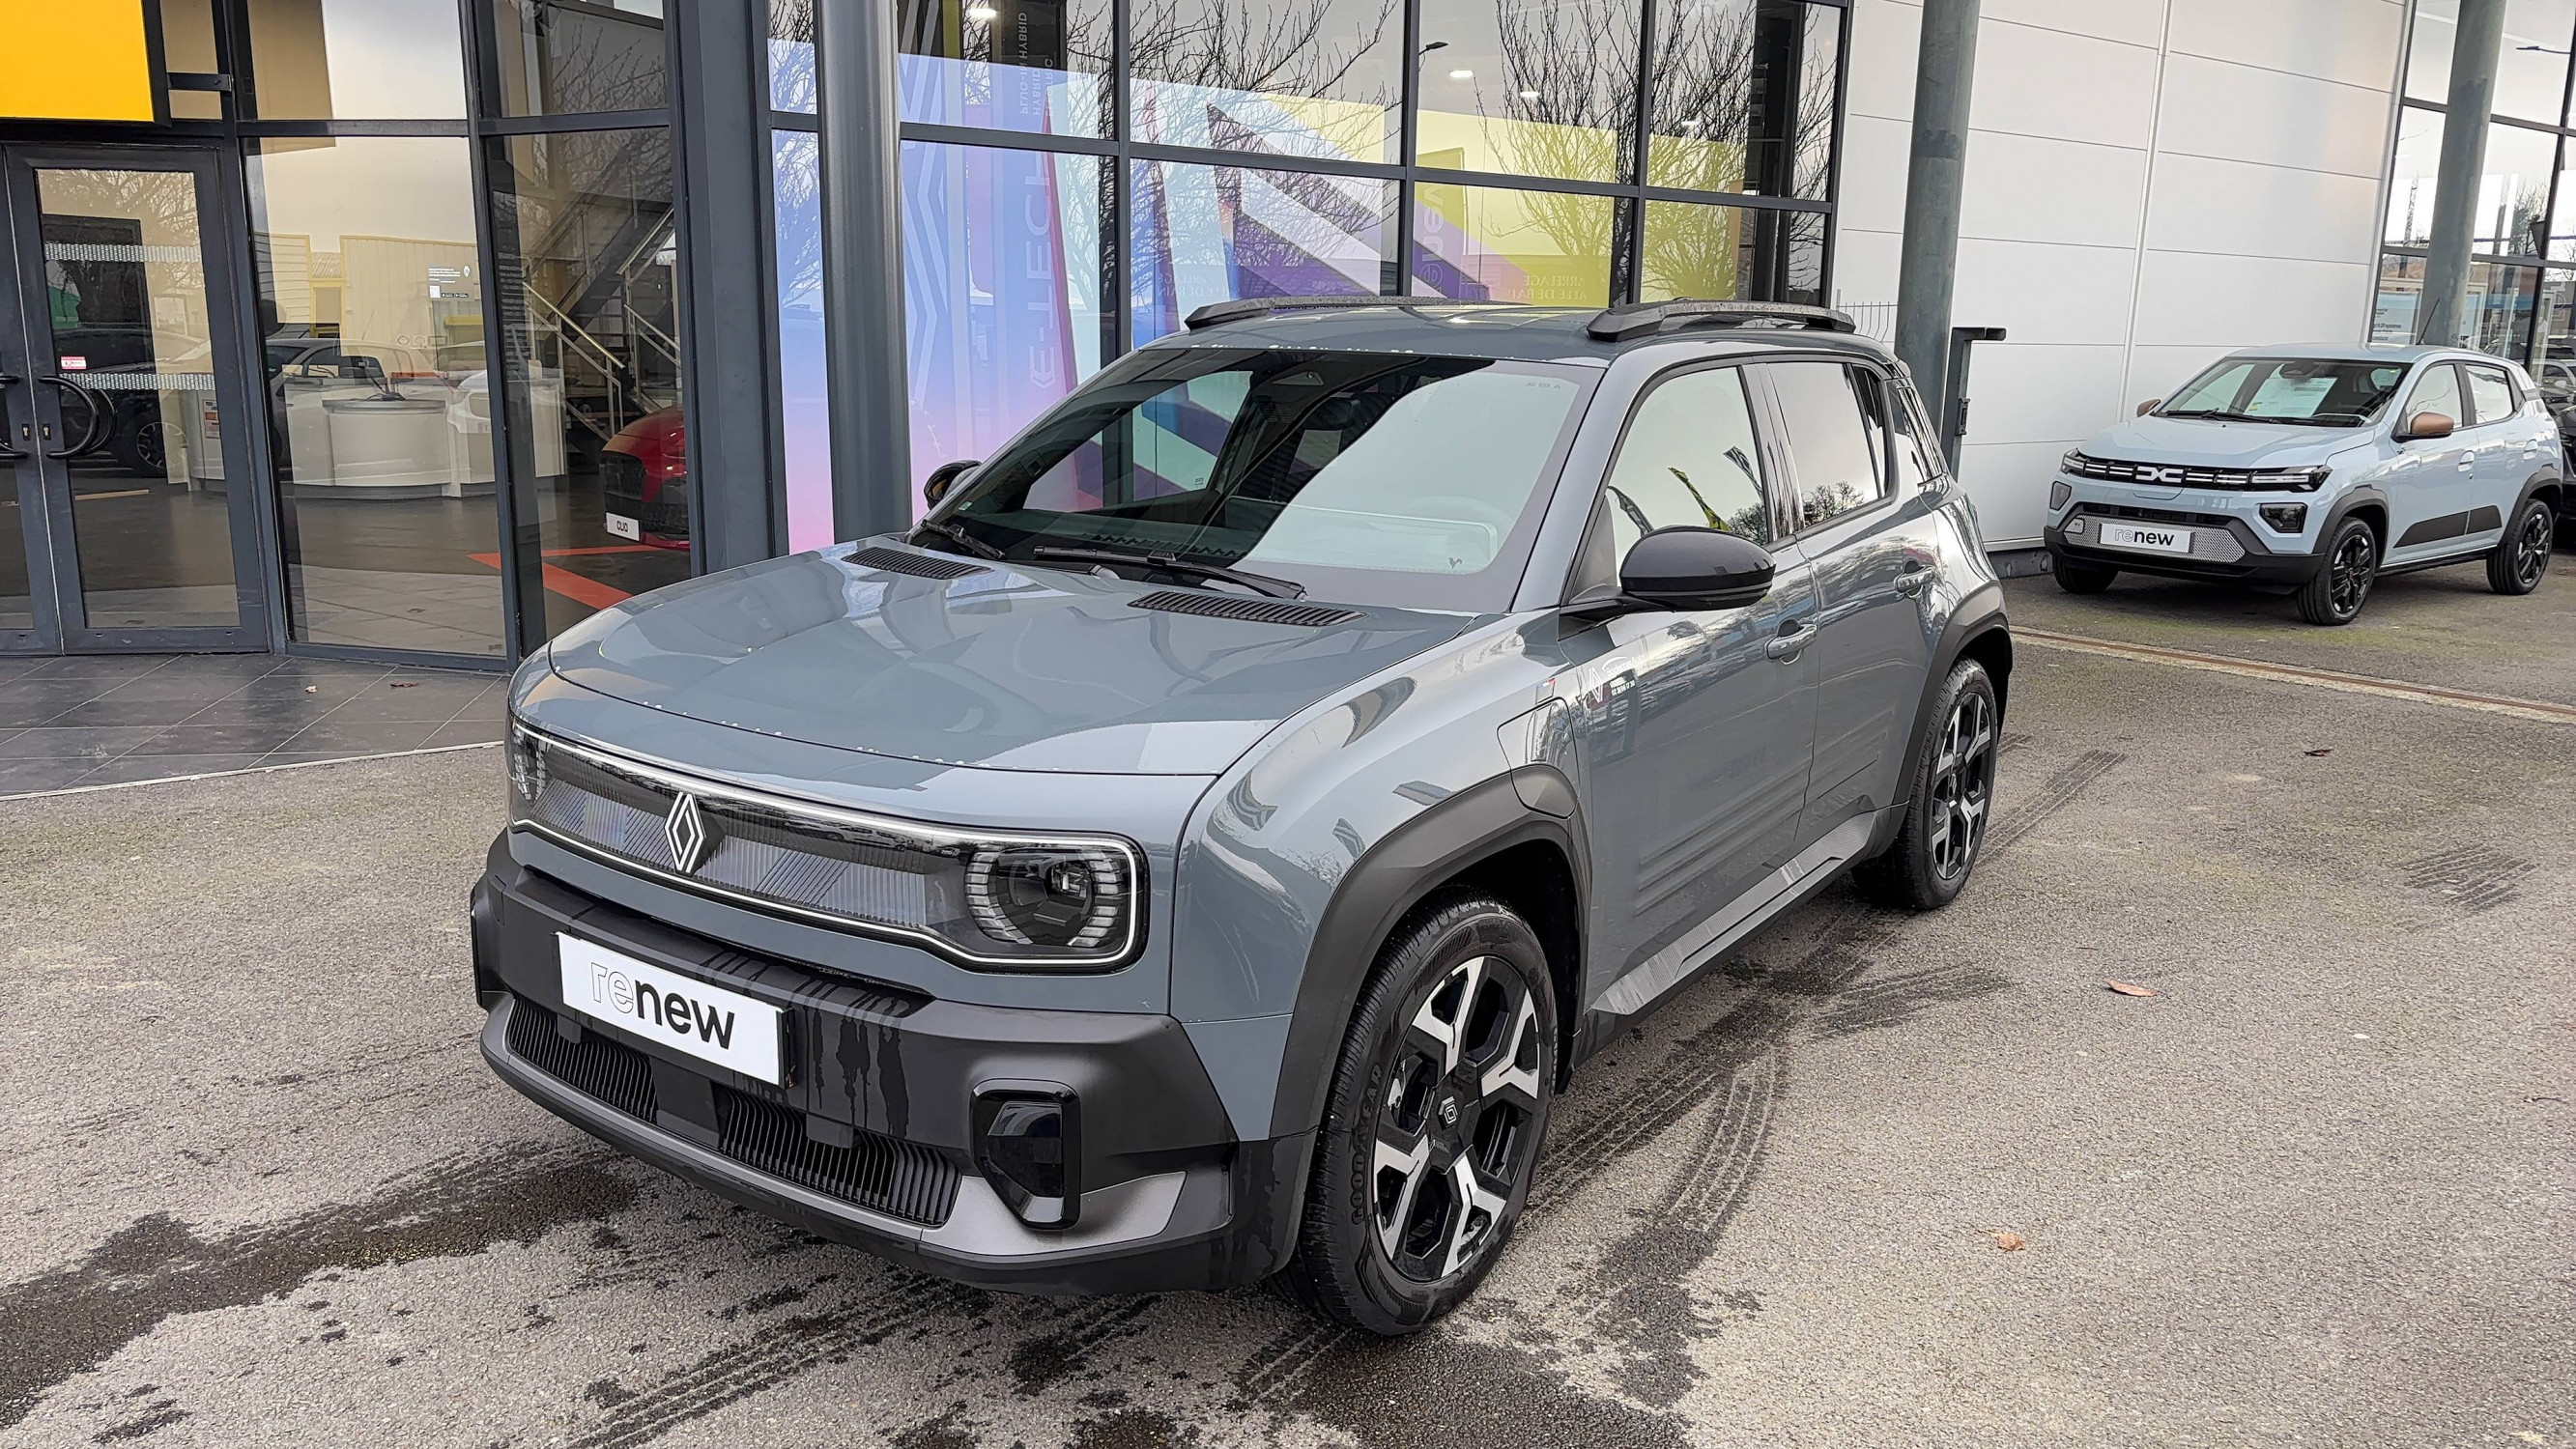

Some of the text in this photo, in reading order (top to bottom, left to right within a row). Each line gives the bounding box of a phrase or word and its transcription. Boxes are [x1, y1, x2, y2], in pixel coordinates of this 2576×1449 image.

[615, 520, 628, 532] CLIO
[2114, 528, 2175, 546] renew
[590, 961, 735, 1050] renew
[1351, 1064, 1383, 1225] GOODYEAR
